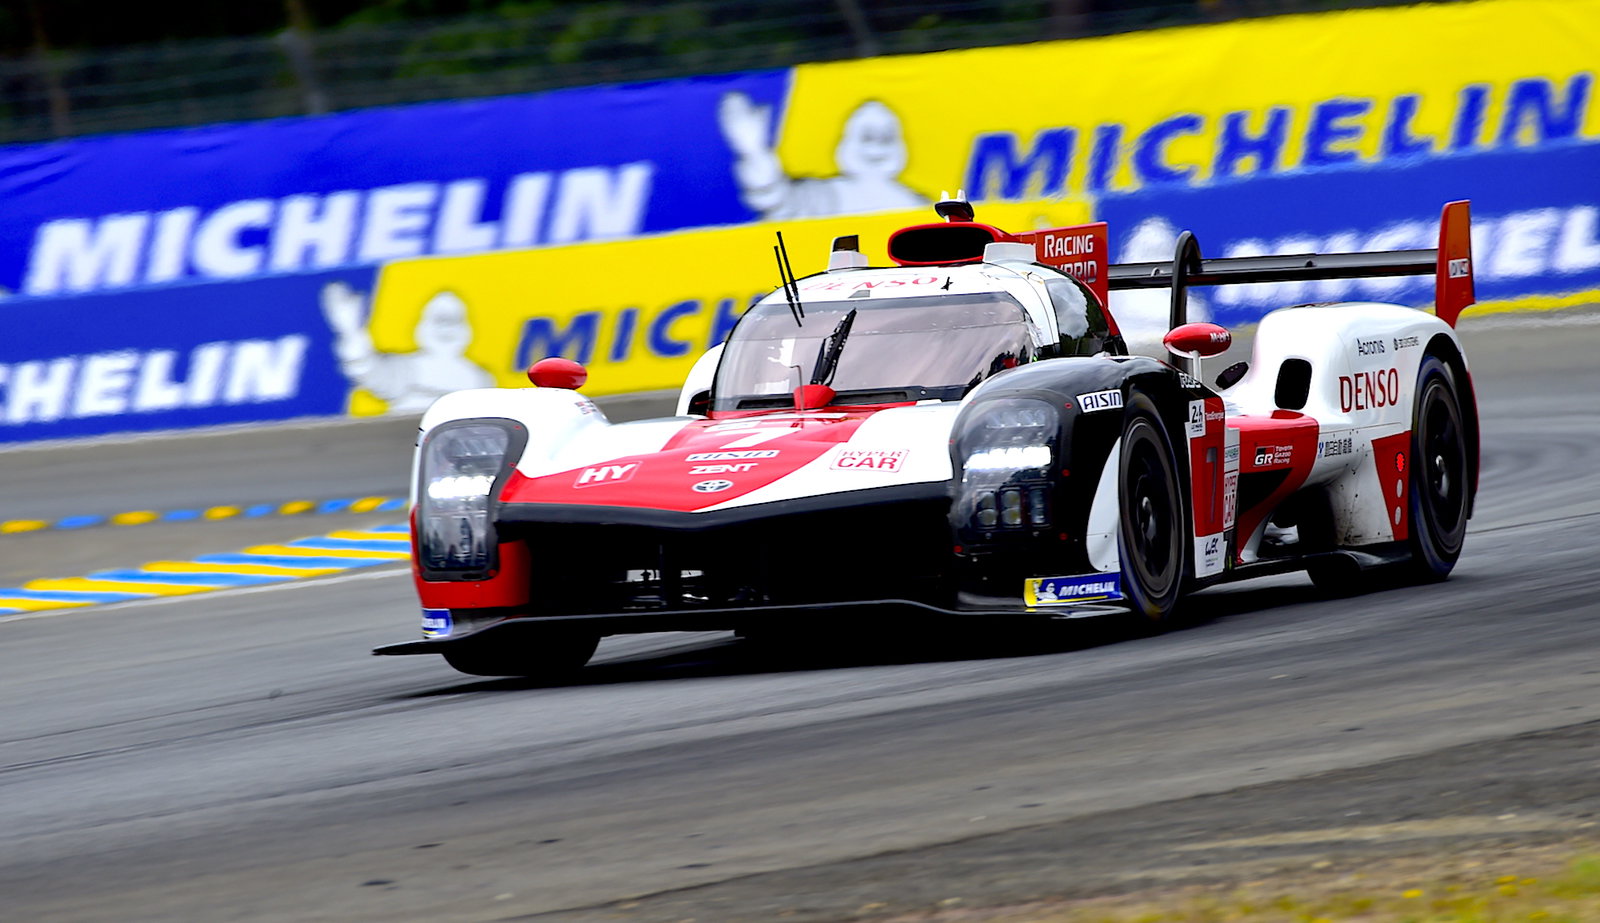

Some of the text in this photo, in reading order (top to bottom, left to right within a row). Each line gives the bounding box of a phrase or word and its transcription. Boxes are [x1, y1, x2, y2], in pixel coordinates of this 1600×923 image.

[965, 73, 1592, 199] MICHELIN
[25, 162, 653, 295] MICHELIN
[1044, 234, 1094, 258] RACING
[1055, 260, 1097, 283] BRID
[0, 334, 307, 424] HELIN
[1083, 391, 1121, 410] AISIN
[1339, 368, 1399, 413] DENSO
[716, 427, 803, 449] 7
[688, 463, 758, 475] ZENT
[837, 457, 899, 469] CAR
[1255, 454, 1273, 465] GR
[579, 464, 635, 483] HY
[1059, 581, 1115, 597] MICHELIN
